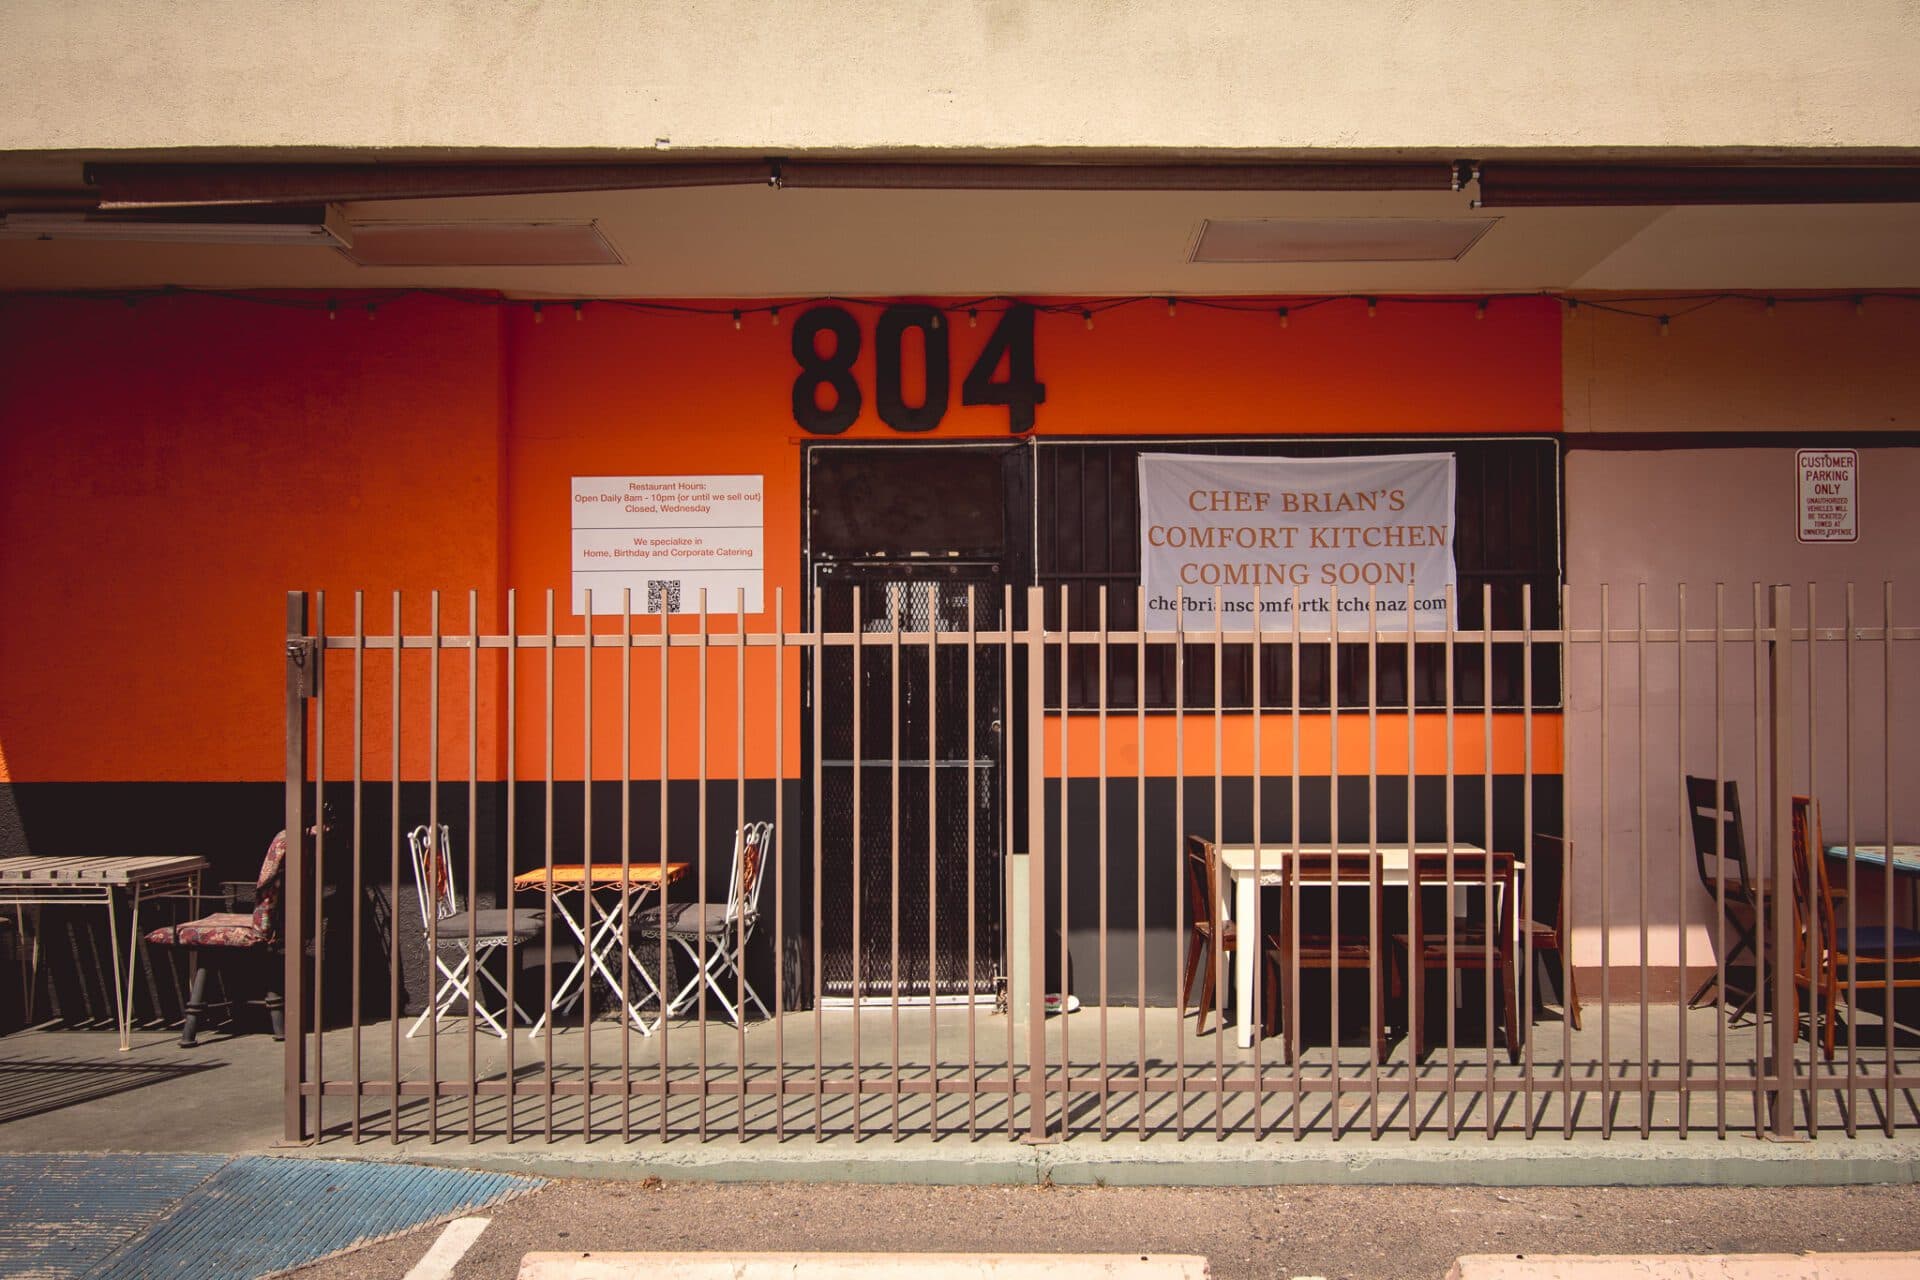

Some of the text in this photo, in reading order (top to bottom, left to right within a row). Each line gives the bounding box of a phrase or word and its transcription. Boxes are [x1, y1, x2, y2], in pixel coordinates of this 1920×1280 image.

[792, 303, 1046, 435] 804
[1801, 457, 1853, 468] CUSTOMER
[1806, 471, 1848, 481] PARKING
[629, 482, 706, 491] Restaurant Hours:
[1815, 484, 1840, 494] ONLY
[574, 494, 599, 504] Open
[600, 494, 621, 504] Daily
[624, 494, 643, 502] 8am
[651, 494, 675, 503] 10pm
[678, 493, 690, 503] (or
[691, 493, 710, 501] until
[727, 492, 742, 501] sell
[744, 493, 761, 503] out)
[1189, 489, 1406, 512] CHEF BRIAN’S
[625, 504, 711, 514] Closed, Wednesday
[633, 537, 703, 547] We specialize in
[1148, 525, 1448, 548] COMFORT KITCHEN
[583, 548, 753, 559] Home, Birthday and Corporate Catering
[1180, 562, 1416, 585] COMING SOON!
